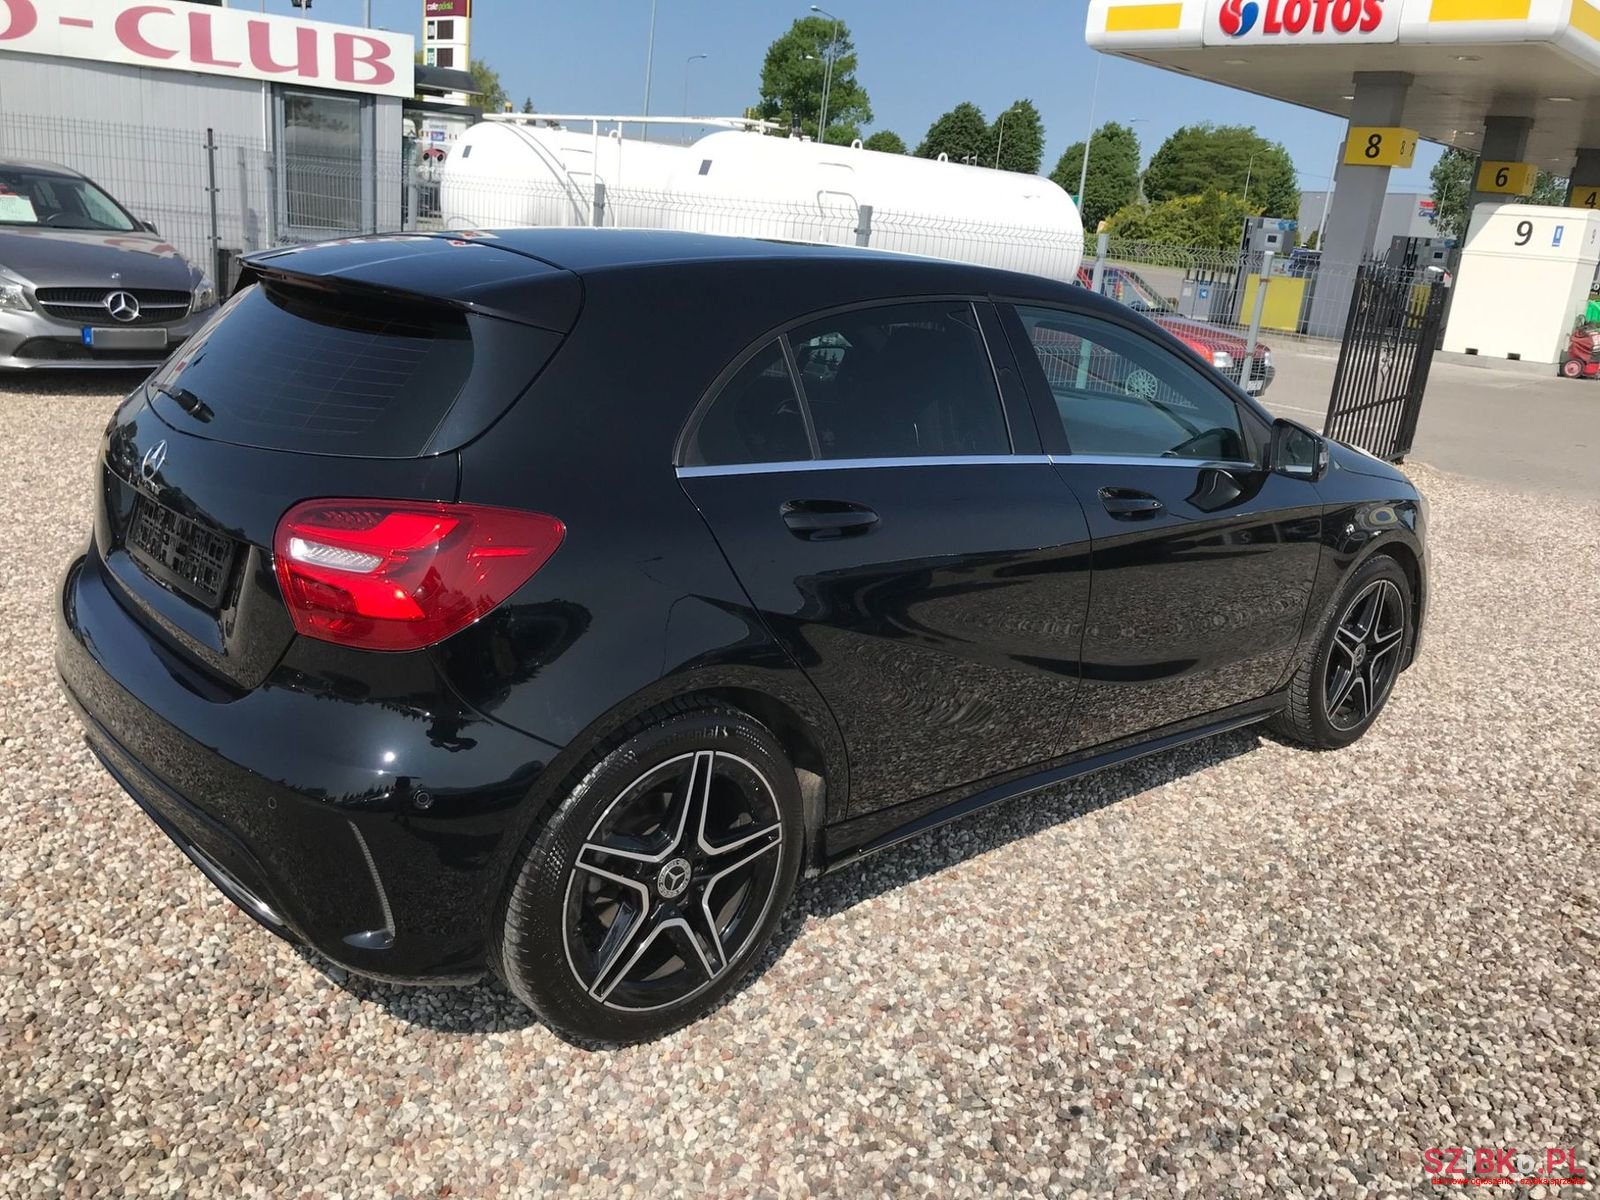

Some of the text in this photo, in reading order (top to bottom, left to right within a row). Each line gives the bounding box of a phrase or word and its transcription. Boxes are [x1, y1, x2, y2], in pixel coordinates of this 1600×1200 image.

[1263, 0, 1383, 33] LOTOS
[1365, 133, 1382, 158] 8
[1495, 166, 1510, 187] 6
[1584, 191, 1598, 208] 4
[1514, 220, 1533, 246] 9
